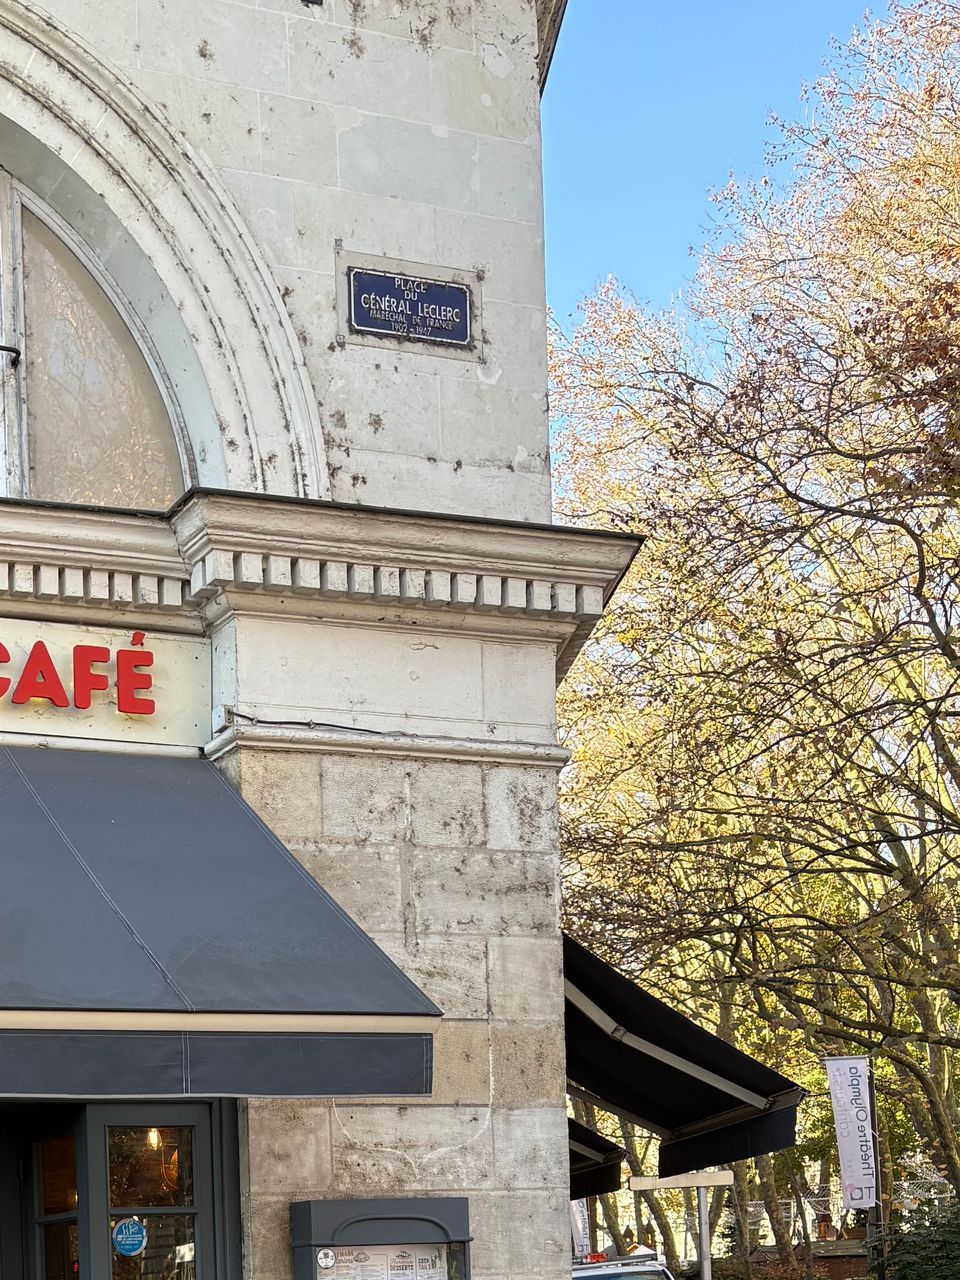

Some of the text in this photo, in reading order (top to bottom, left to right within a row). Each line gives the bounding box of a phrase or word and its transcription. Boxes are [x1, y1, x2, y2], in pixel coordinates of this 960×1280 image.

[395, 278, 426, 293] PLACE
[404, 291, 418, 300] DU
[361, 293, 460, 322] GÉNÉRAL LECLERC
[412, 315, 422, 326] DE
[426, 318, 454, 331] FRANCE
